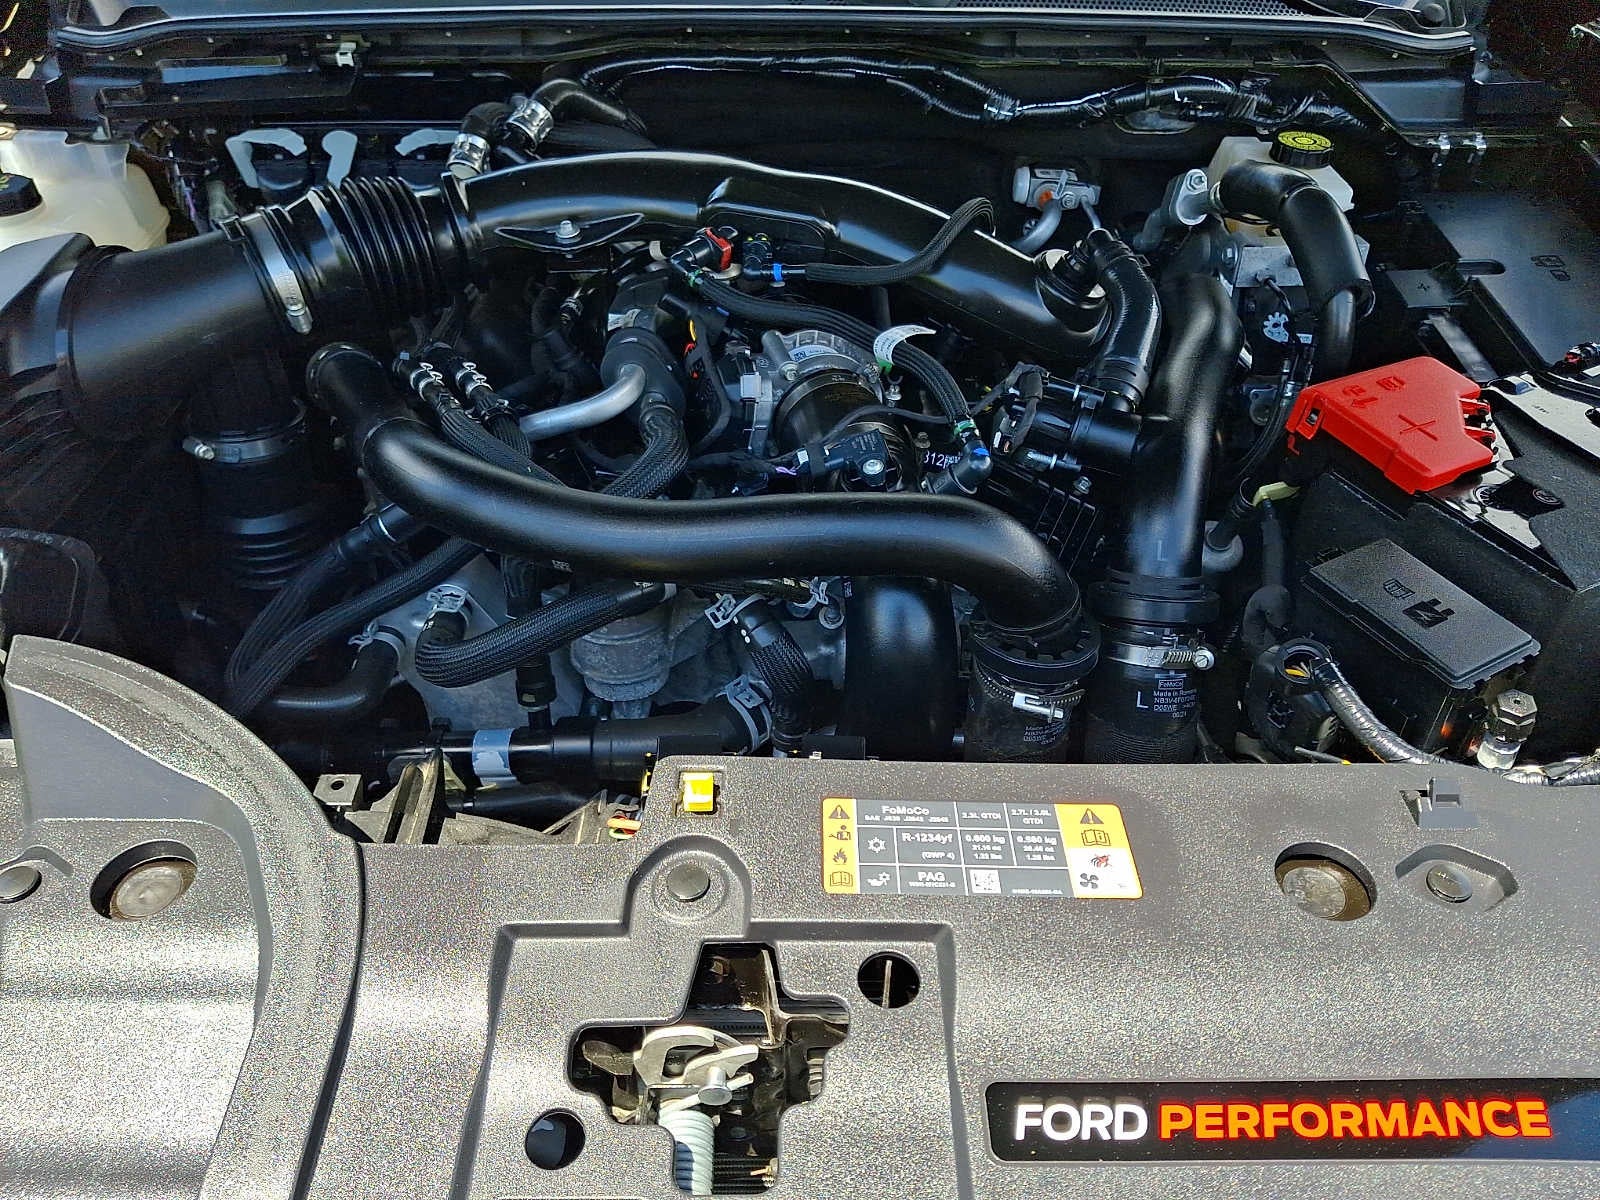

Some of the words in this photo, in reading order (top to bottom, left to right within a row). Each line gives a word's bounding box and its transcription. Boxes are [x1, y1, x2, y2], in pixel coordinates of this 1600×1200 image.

[1136, 691, 1149, 709] L
[881, 805, 930, 816] FoMoCo
[901, 832, 953, 845] R-1234yf
[917, 871, 945, 882] PAG
[1014, 1103, 1148, 1141] FORD
[1158, 1100, 1552, 1140] PERFORMANCE
